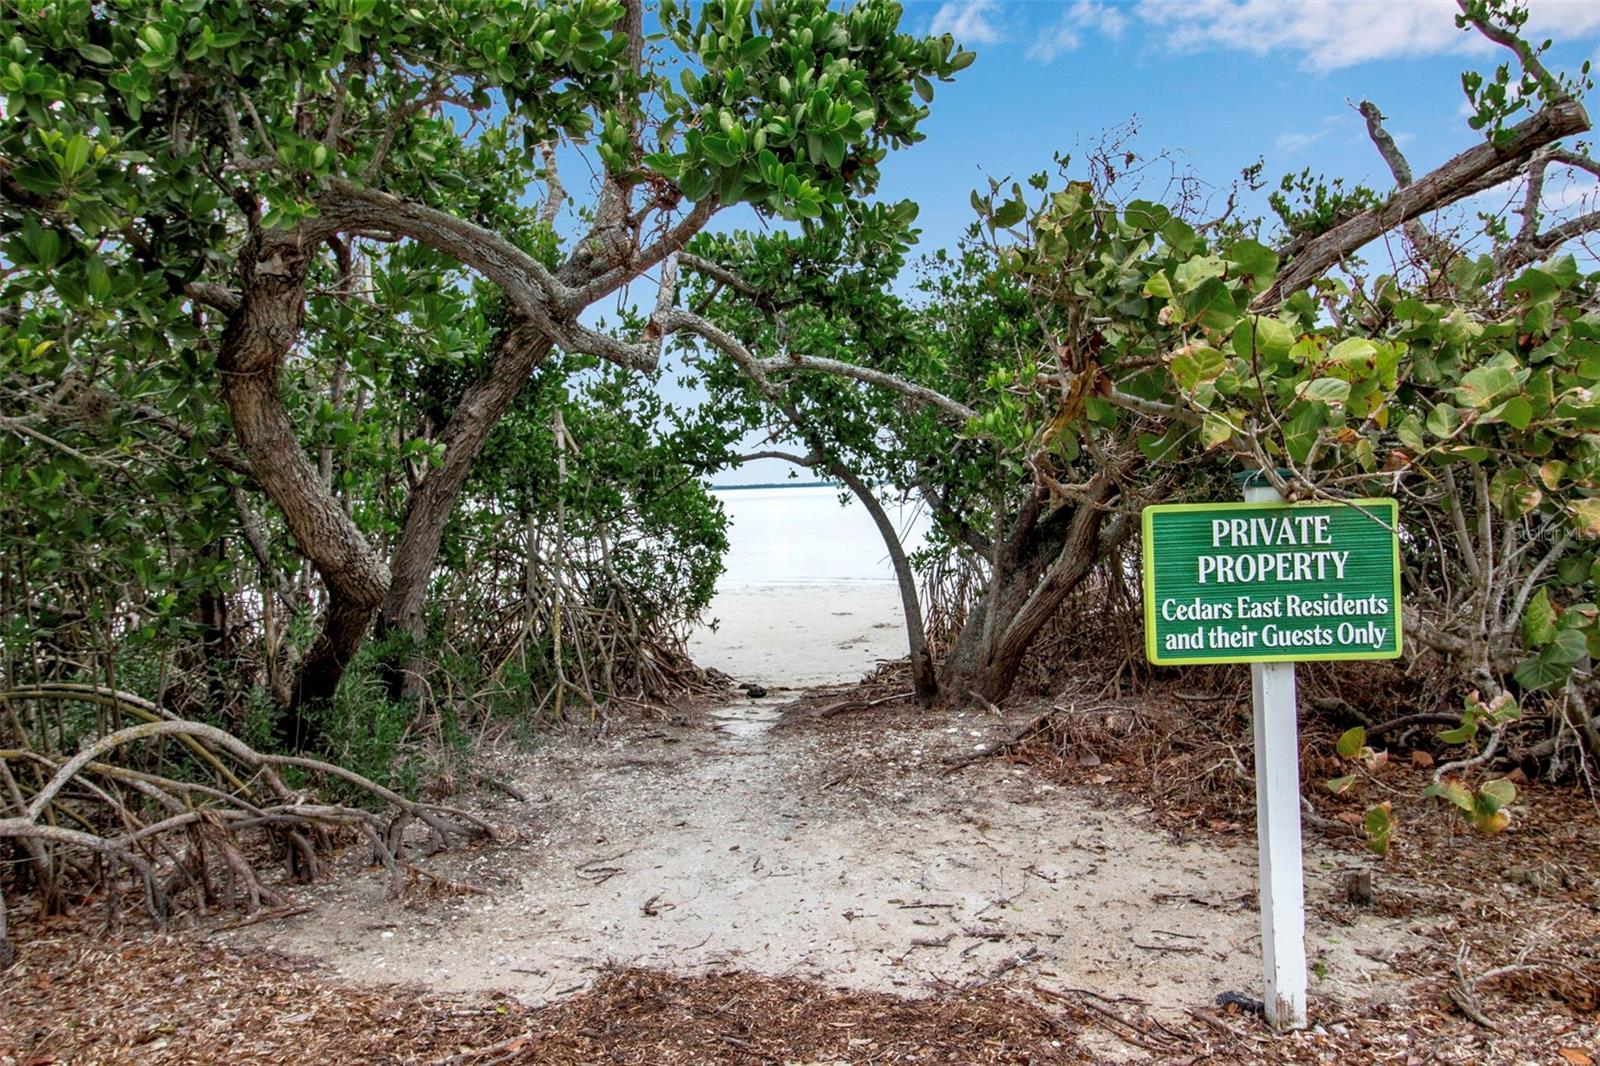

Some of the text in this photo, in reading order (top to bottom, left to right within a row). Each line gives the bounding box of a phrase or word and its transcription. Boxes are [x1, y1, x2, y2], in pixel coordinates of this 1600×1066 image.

[1211, 515, 1332, 547] PRIVATE
[1198, 551, 1349, 584] PROPERTY
[1162, 593, 1388, 621] Cedars East Residents
[1165, 621, 1387, 650] and their Guests Only
